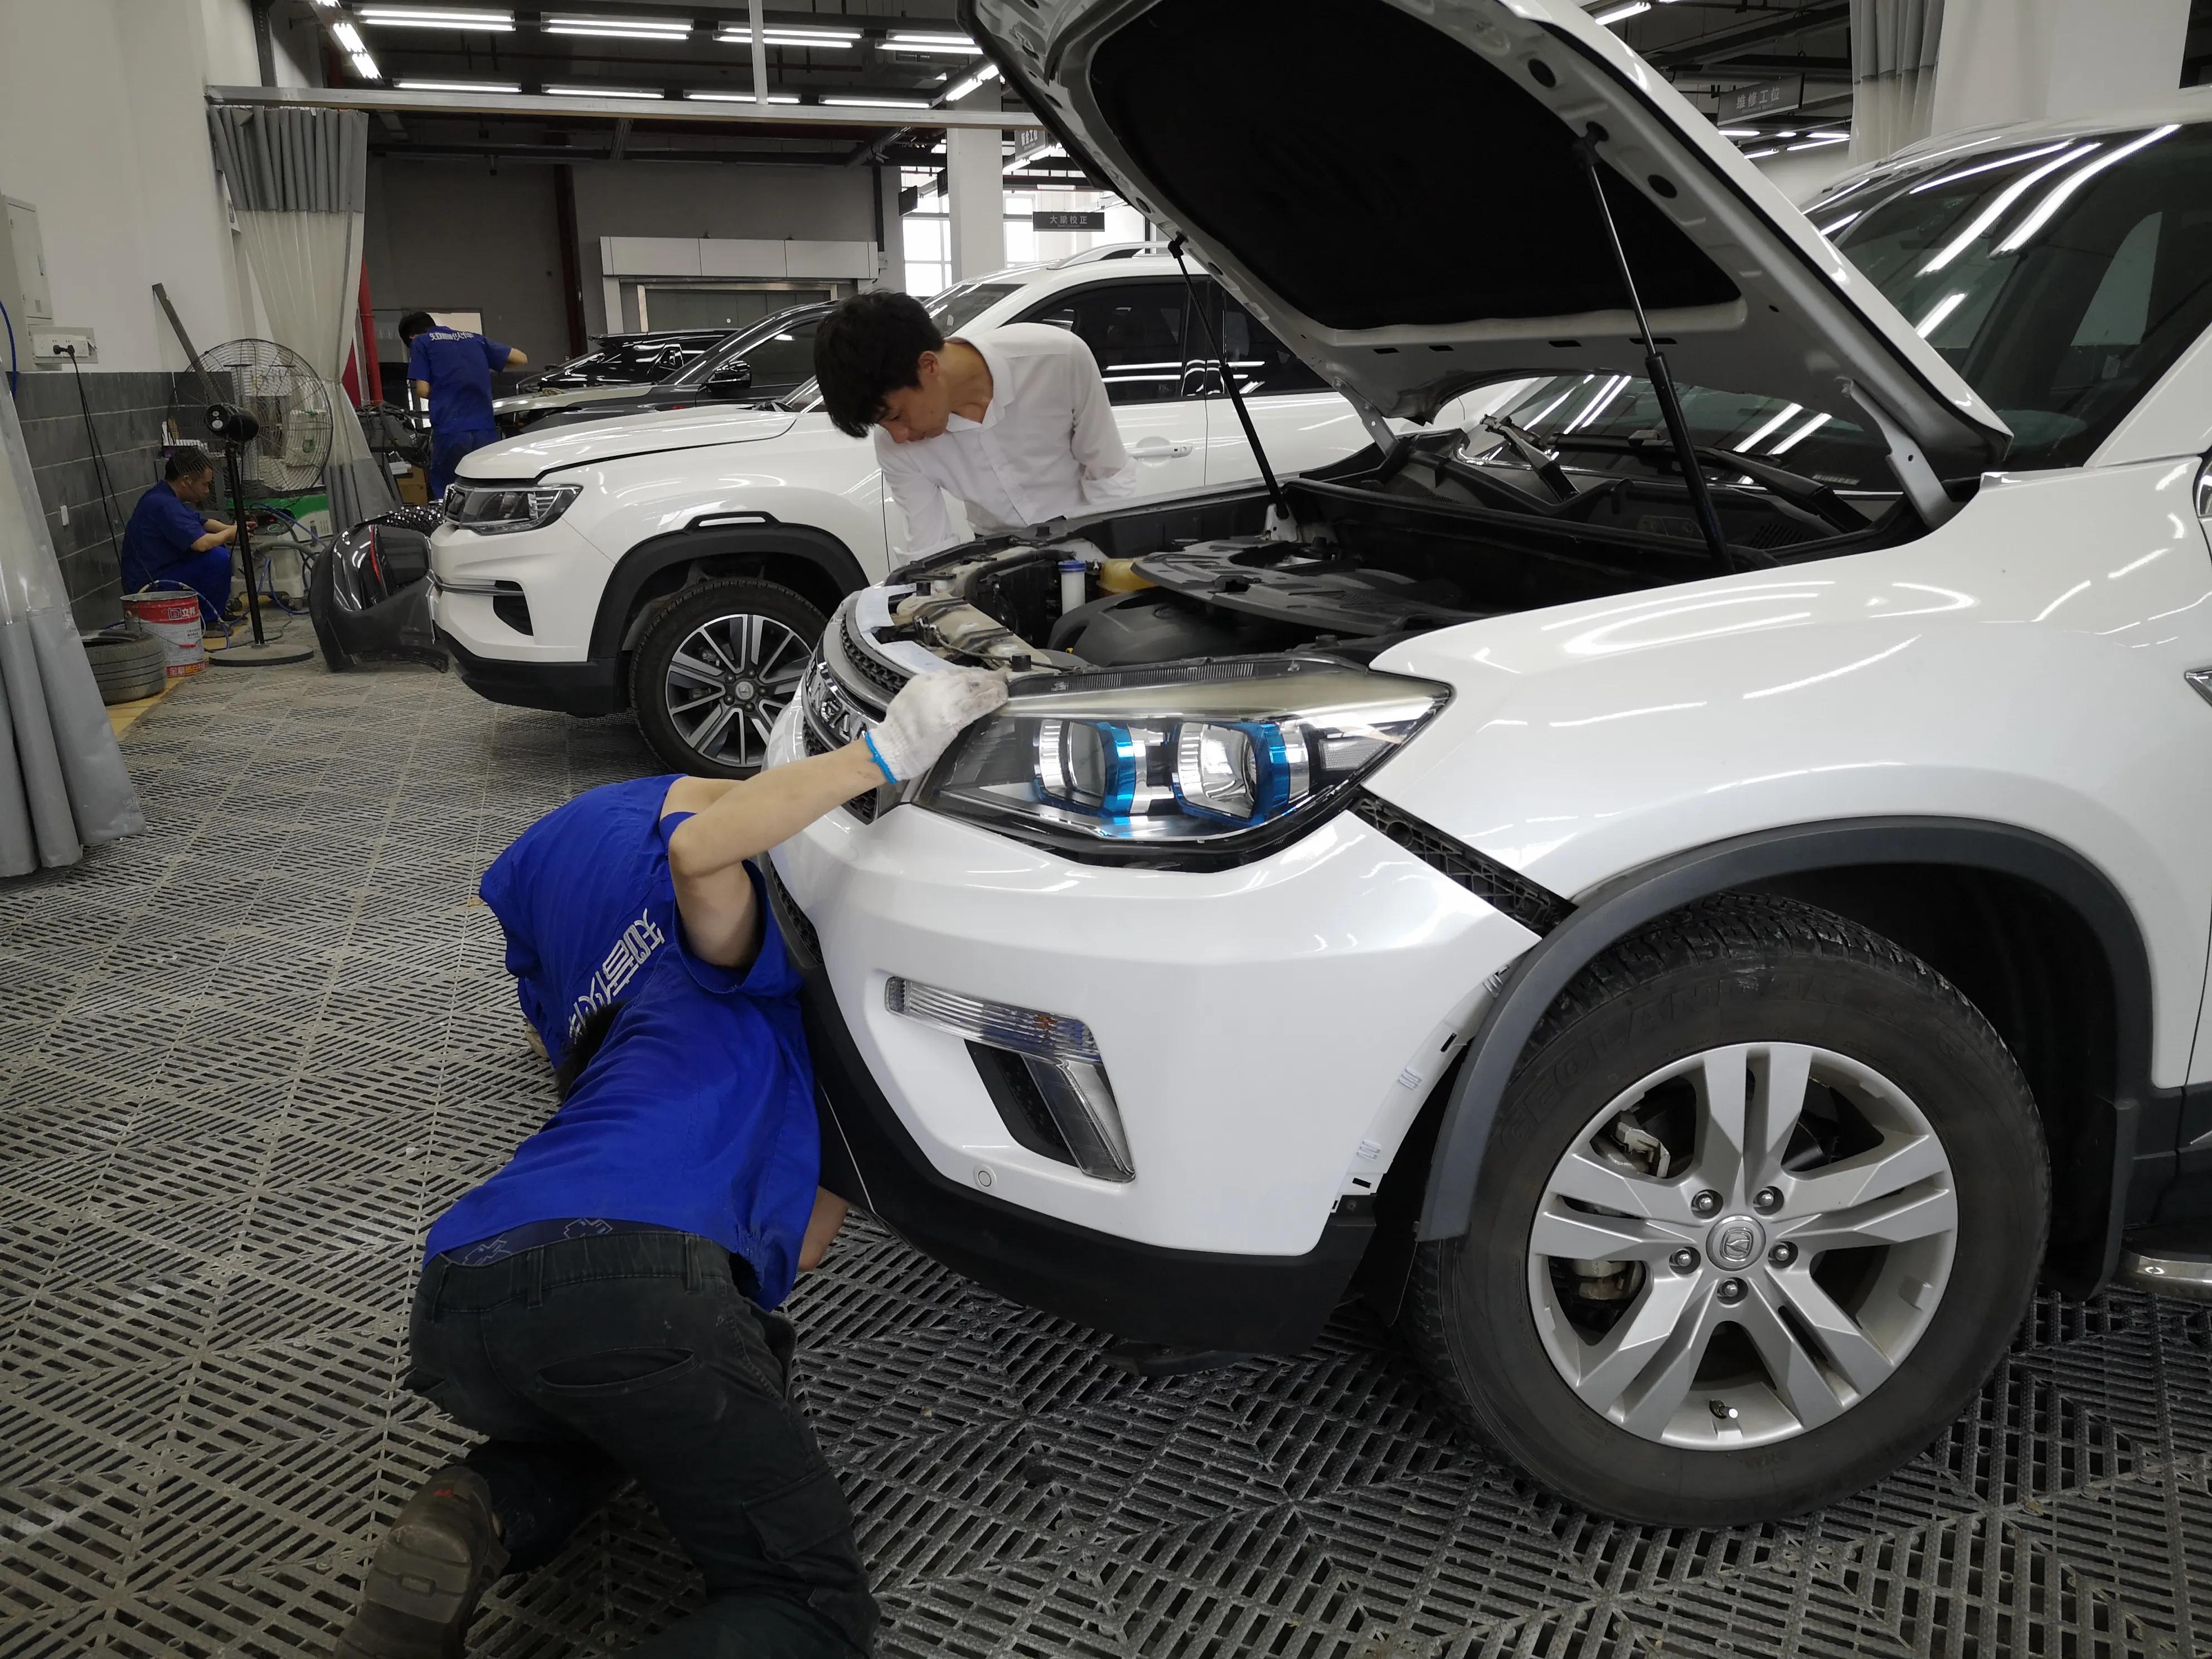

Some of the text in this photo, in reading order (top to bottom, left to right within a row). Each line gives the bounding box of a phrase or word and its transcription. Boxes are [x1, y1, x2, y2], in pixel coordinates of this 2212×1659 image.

[1736, 85, 1781, 110] 维修工位
[1050, 215, 1088, 225] 大梁校正
